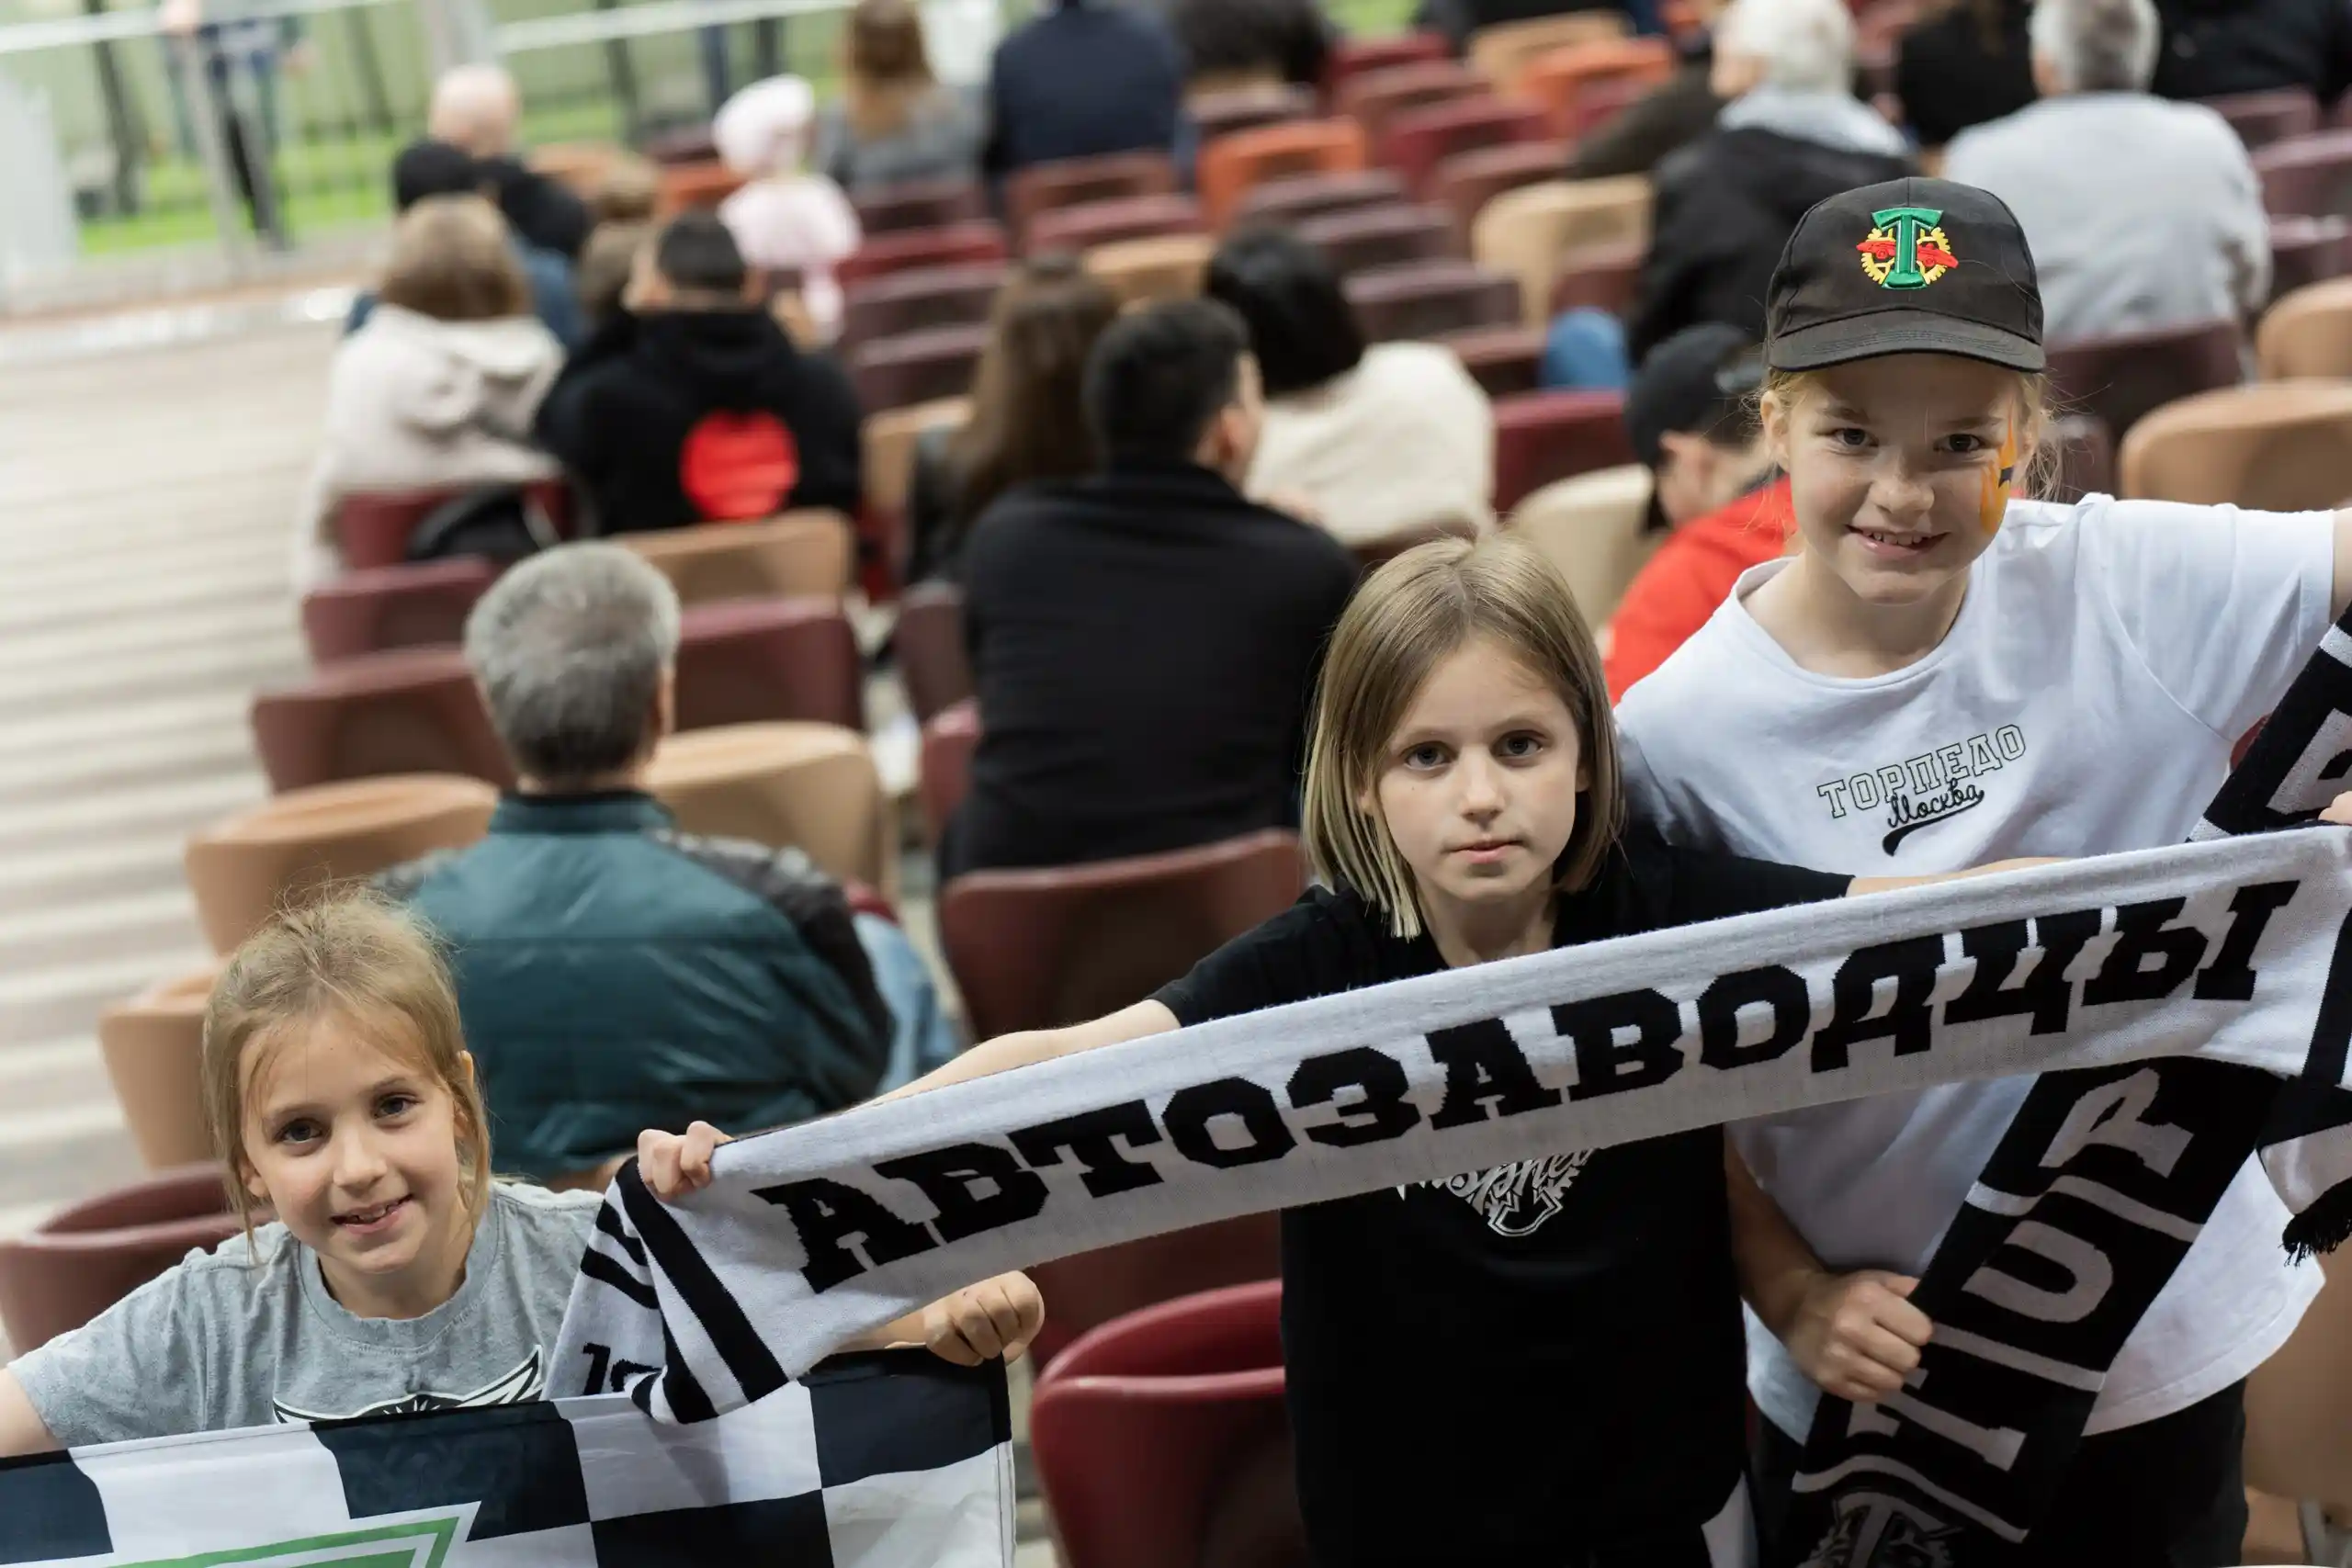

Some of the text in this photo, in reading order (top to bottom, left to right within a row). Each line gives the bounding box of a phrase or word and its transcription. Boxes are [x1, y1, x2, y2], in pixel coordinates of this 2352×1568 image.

[1817, 724, 2027, 818] ТОРПЕДО
[1886, 778, 1982, 836] Москва
[751, 880, 2300, 1293] АВТОЗАВОДЦЫ
